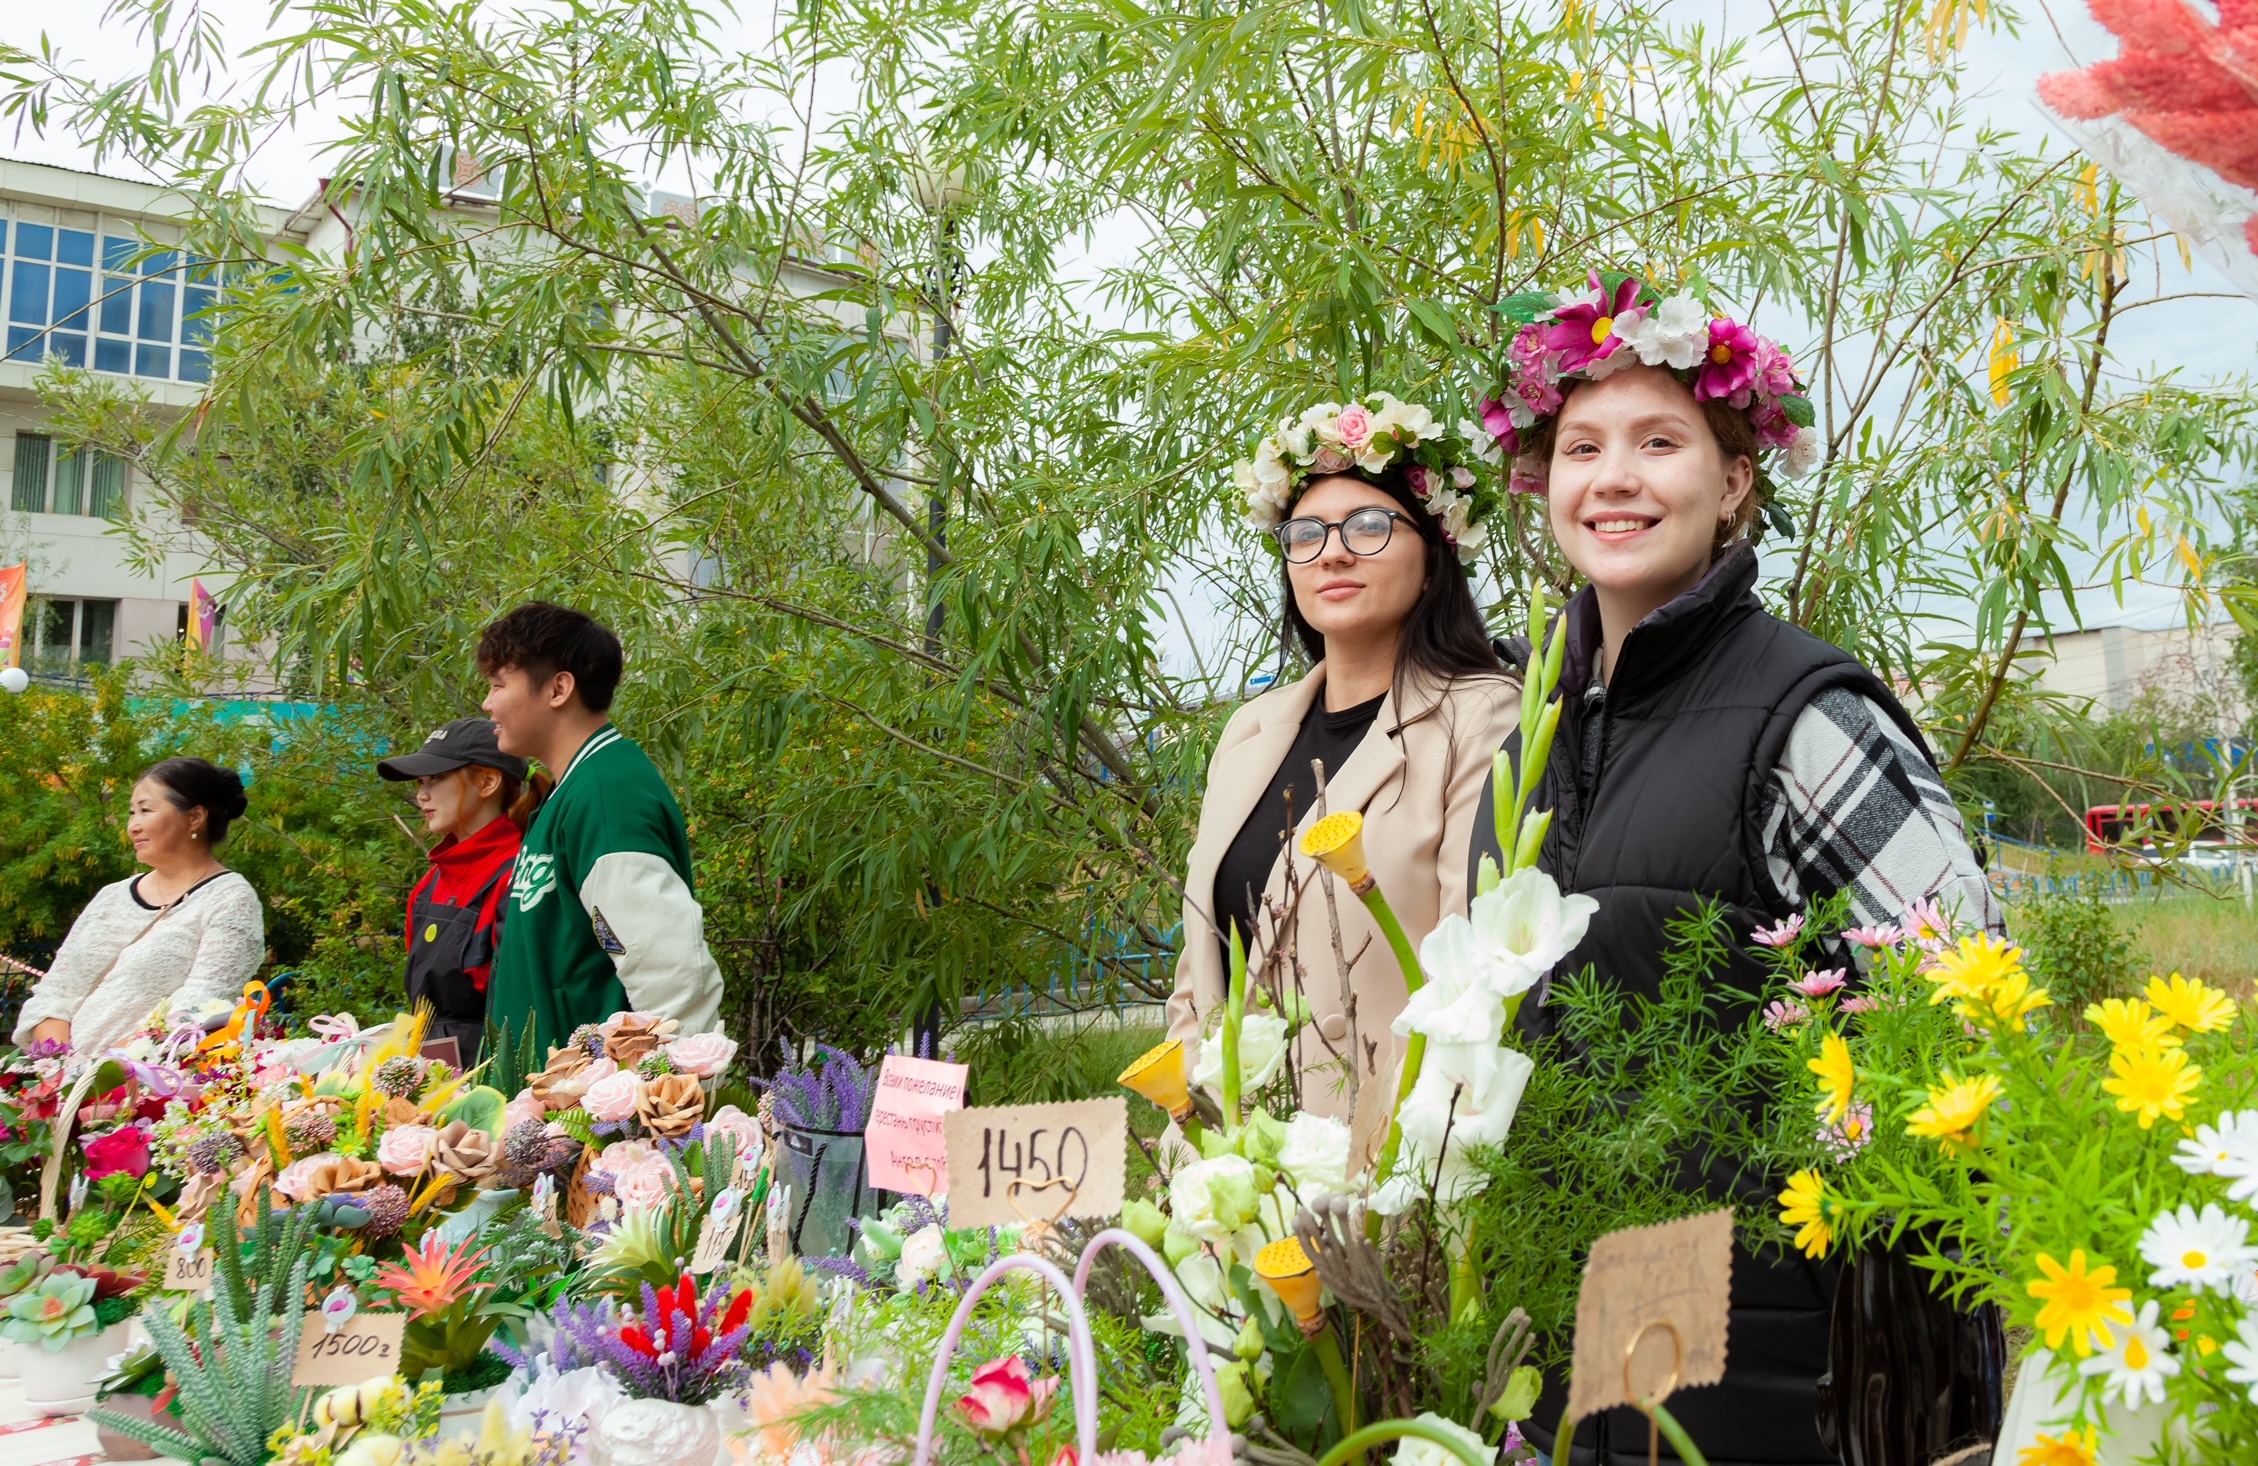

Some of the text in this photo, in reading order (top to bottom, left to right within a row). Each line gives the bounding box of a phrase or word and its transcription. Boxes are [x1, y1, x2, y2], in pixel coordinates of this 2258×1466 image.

[904, 1076, 957, 1100] пожелание
[978, 1127, 1088, 1197] 1450
[176, 1257, 207, 1279] 800
